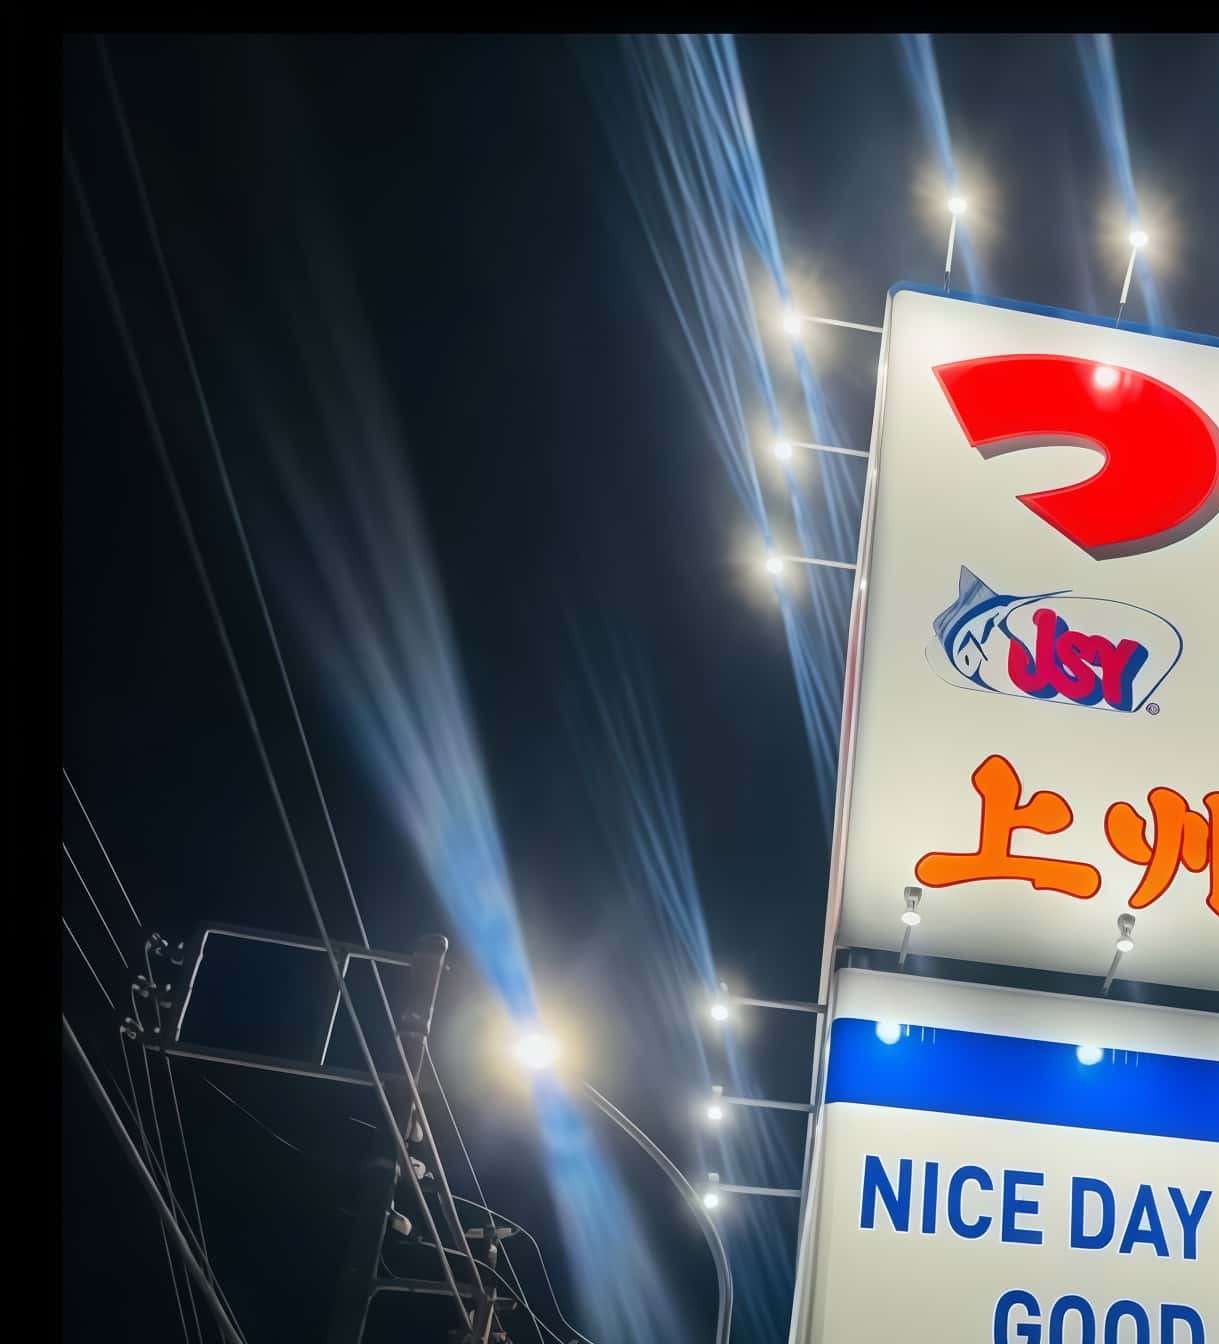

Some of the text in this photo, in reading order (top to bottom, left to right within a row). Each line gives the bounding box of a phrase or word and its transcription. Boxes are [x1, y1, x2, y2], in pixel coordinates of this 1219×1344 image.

[1008, 608, 1149, 712] JSY
[860, 1155, 1213, 1260] NICE DAY
